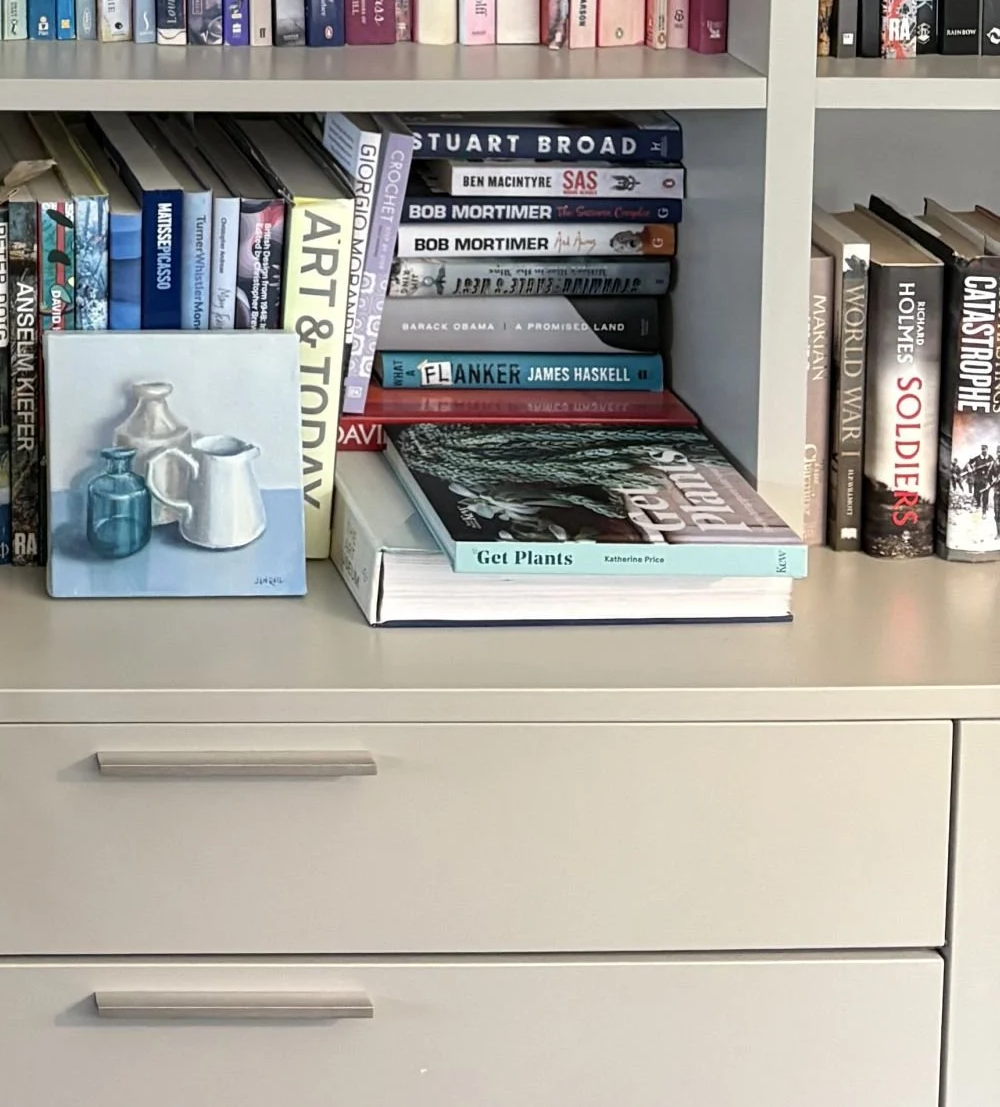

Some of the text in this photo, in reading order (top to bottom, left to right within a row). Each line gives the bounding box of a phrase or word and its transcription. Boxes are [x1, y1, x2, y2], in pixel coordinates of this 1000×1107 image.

[412, 134, 636, 154] STUART BROAD
[379, 151, 404, 222] CROCHET
[463, 170, 597, 189] BEN MACINTYRE SAS
[409, 205, 551, 219] BOB MORTIMER
[415, 237, 548, 251] BOB MORTIMER
[897, 283, 914, 363] HOLMES
[916, 301, 926, 345] RICHARD
[958, 276, 996, 412] CATASTROPHE
[16, 283, 33, 450] ANSELM KIEFER
[296, 211, 341, 509] ART & TODAY
[423, 363, 629, 385] FLANKER JAMES HASKELL
[892, 377, 922, 526] SOLDIERS
[477, 550, 507, 565] Get
[515, 550, 573, 565] Plants
